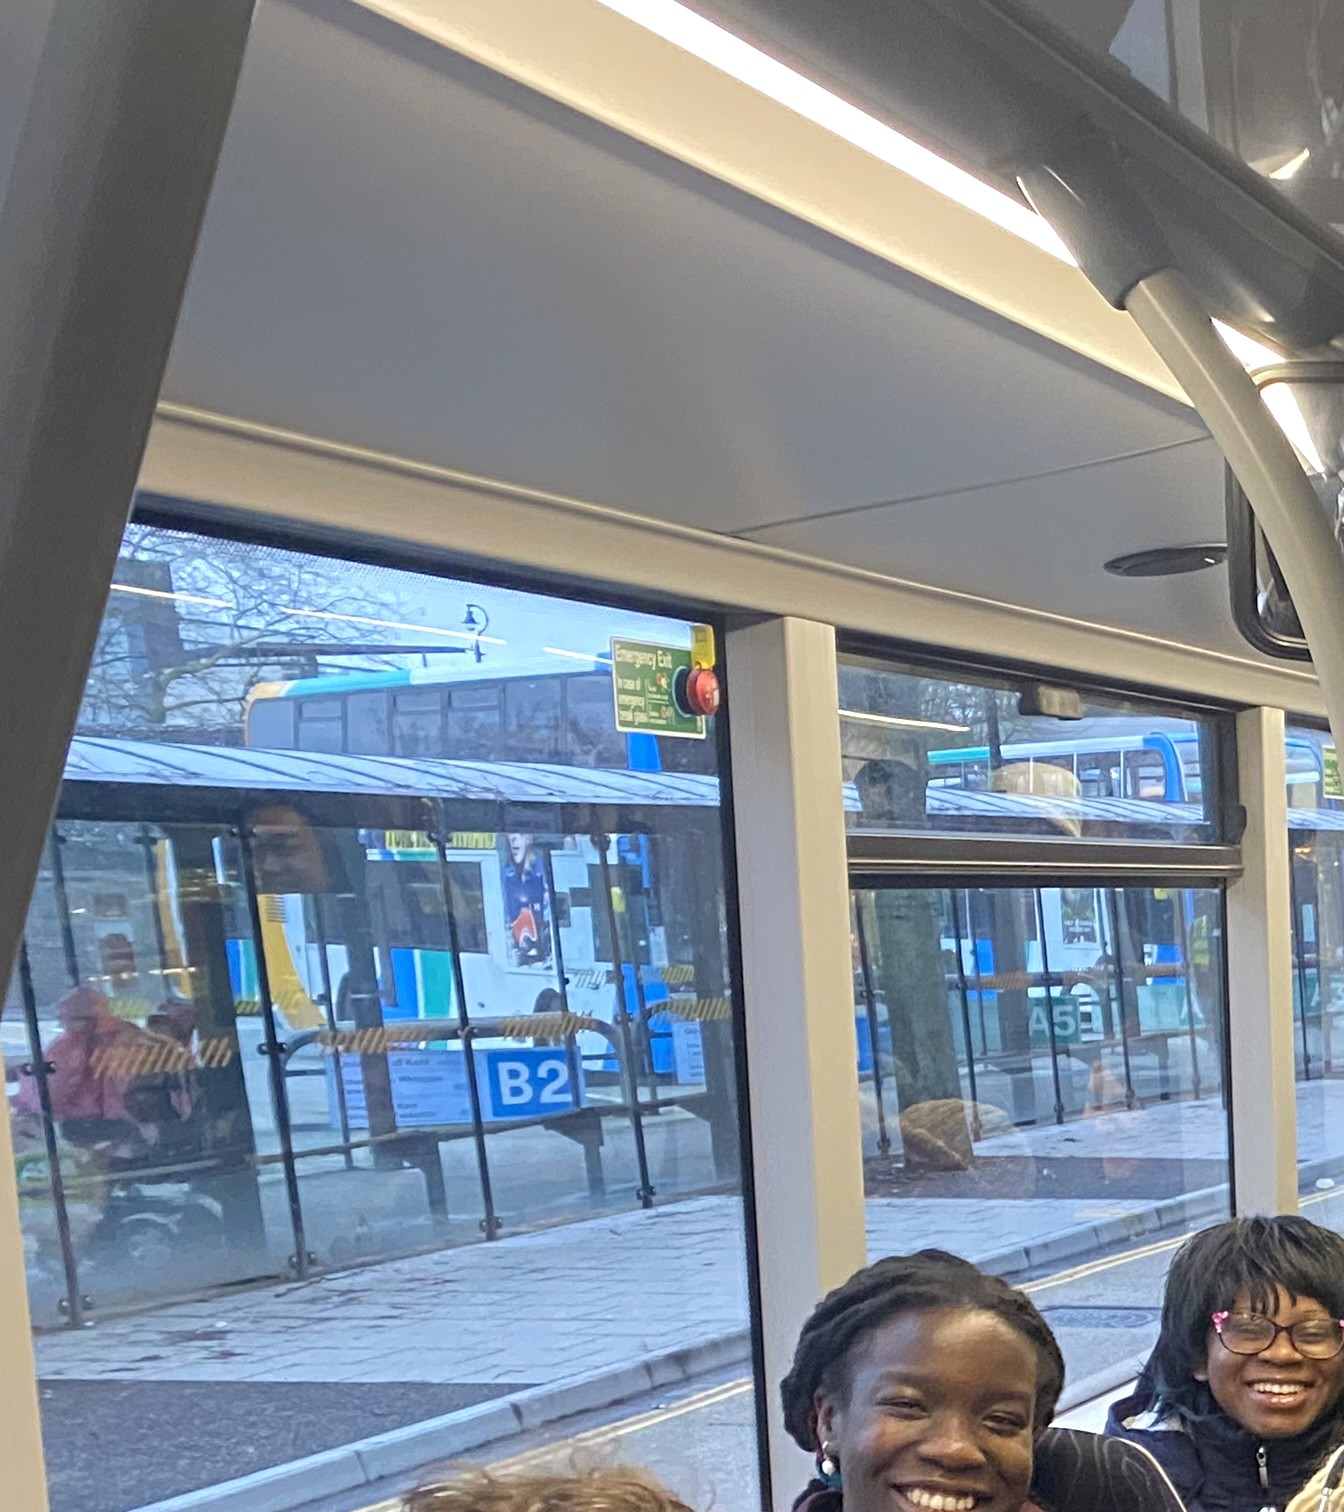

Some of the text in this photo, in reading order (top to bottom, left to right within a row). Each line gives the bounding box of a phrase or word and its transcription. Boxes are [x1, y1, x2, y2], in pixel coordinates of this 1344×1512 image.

[615, 643, 672, 670] Emergency Exit
[1028, 1004, 1077, 1037] A5
[497, 1058, 573, 1106] B2
